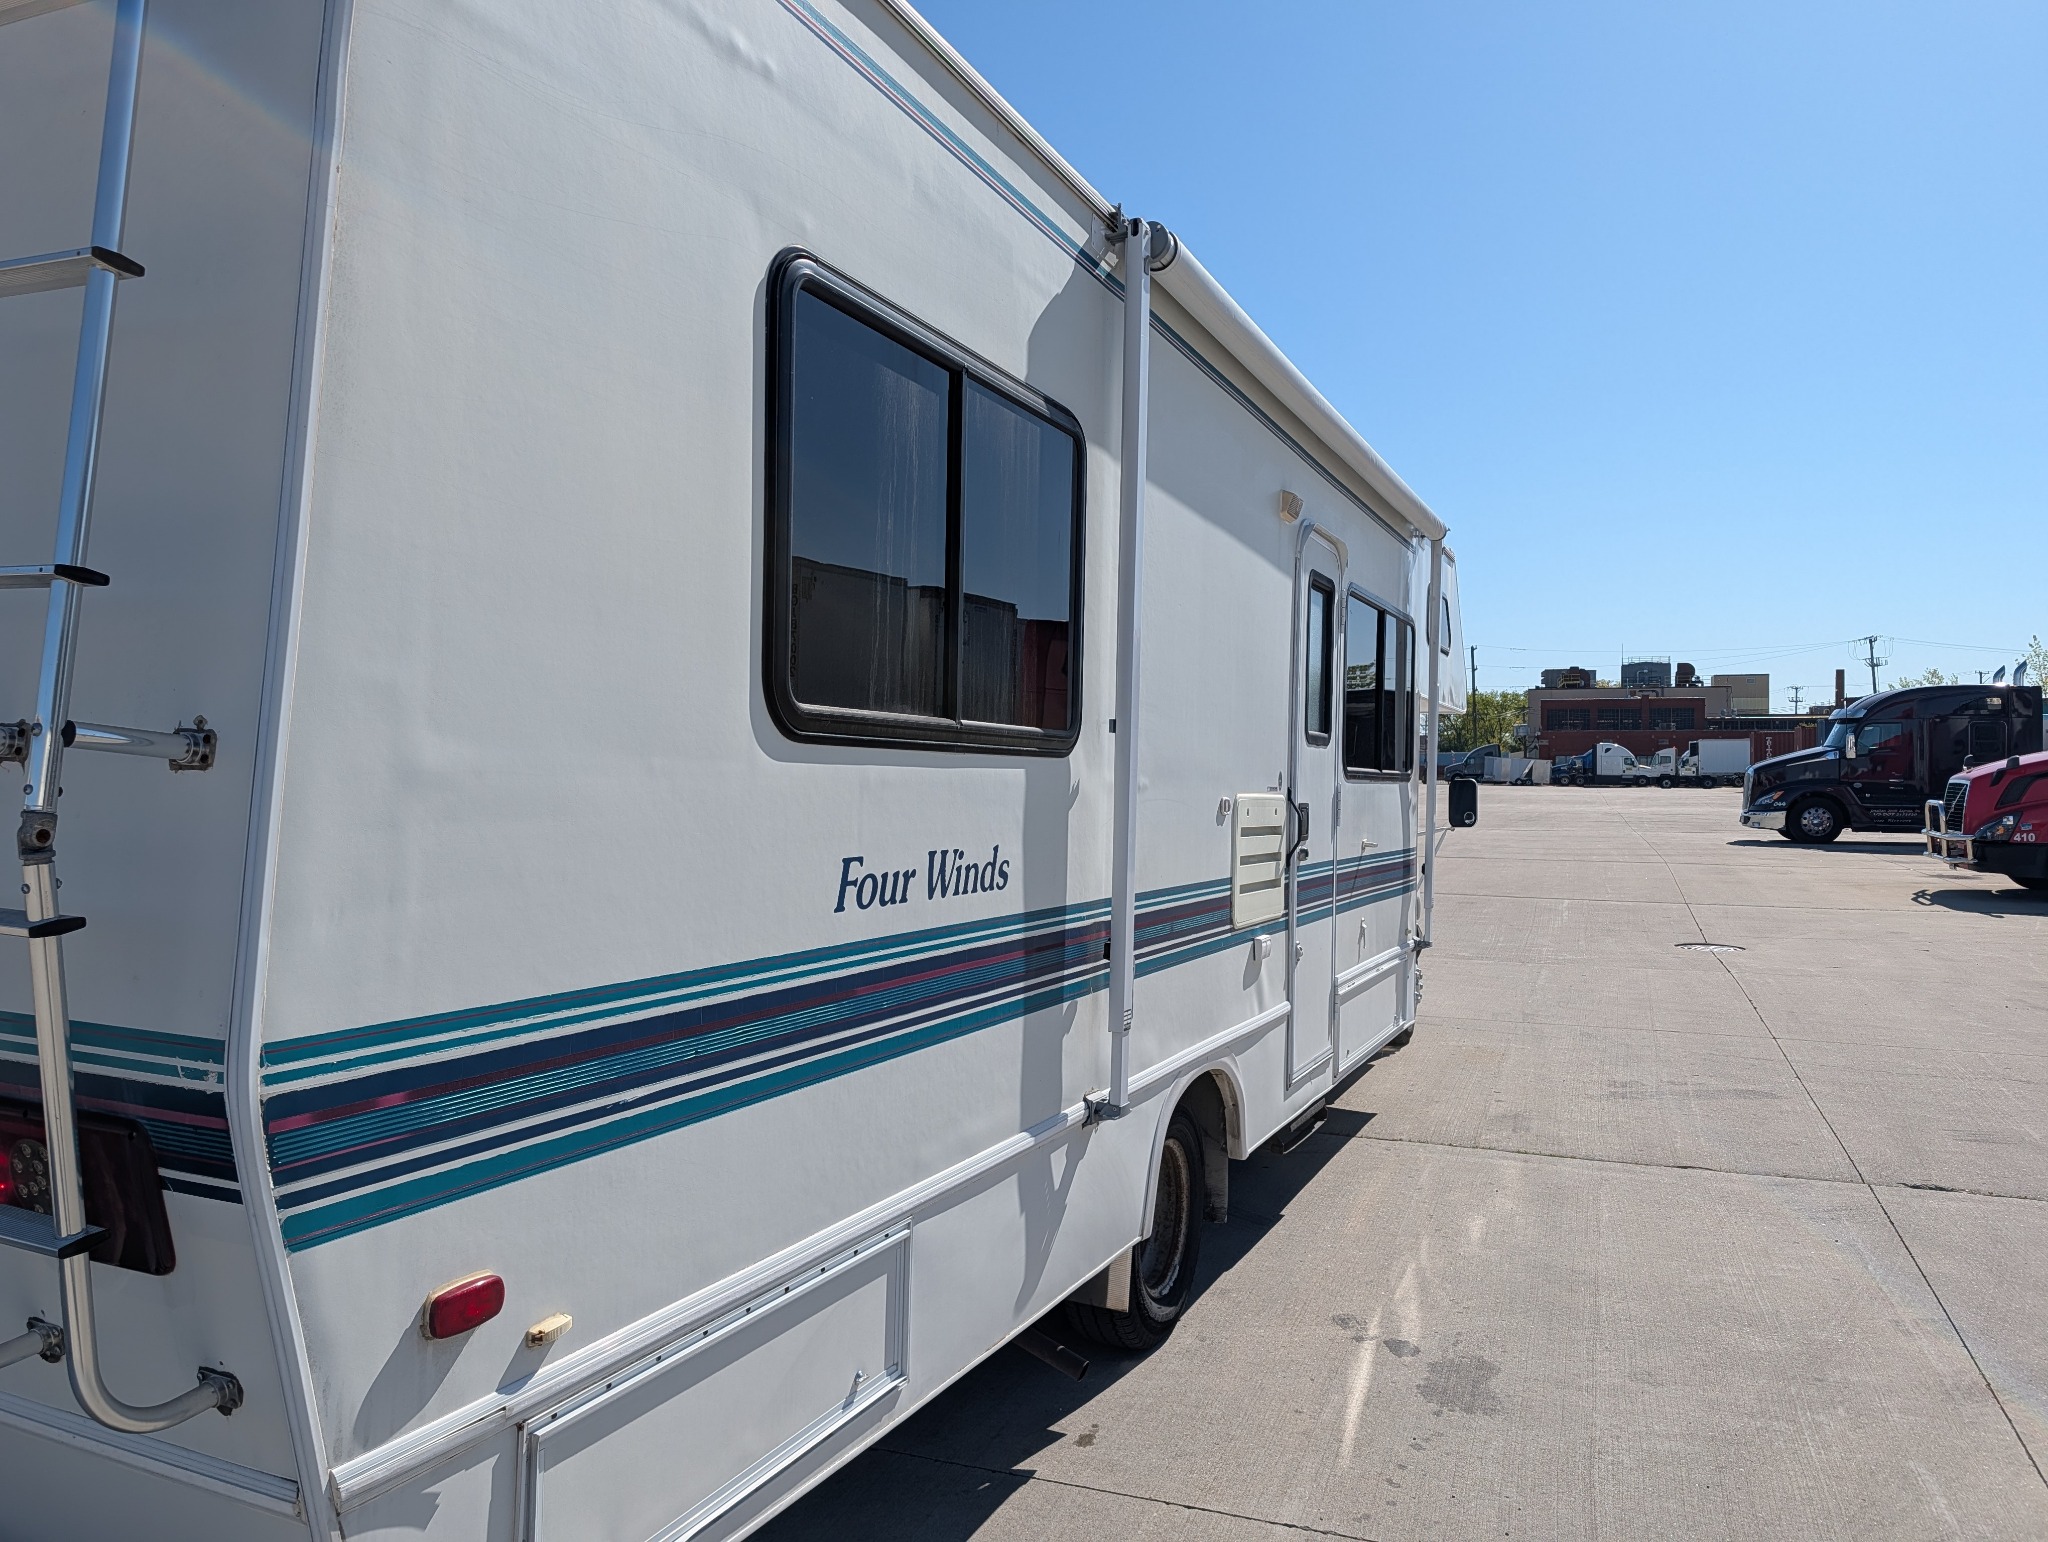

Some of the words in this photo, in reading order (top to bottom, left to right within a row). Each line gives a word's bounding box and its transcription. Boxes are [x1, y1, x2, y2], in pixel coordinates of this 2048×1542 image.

[2013, 832, 2036, 842] 410
[834, 856, 917, 913] Four
[927, 844, 1010, 901] Winds
